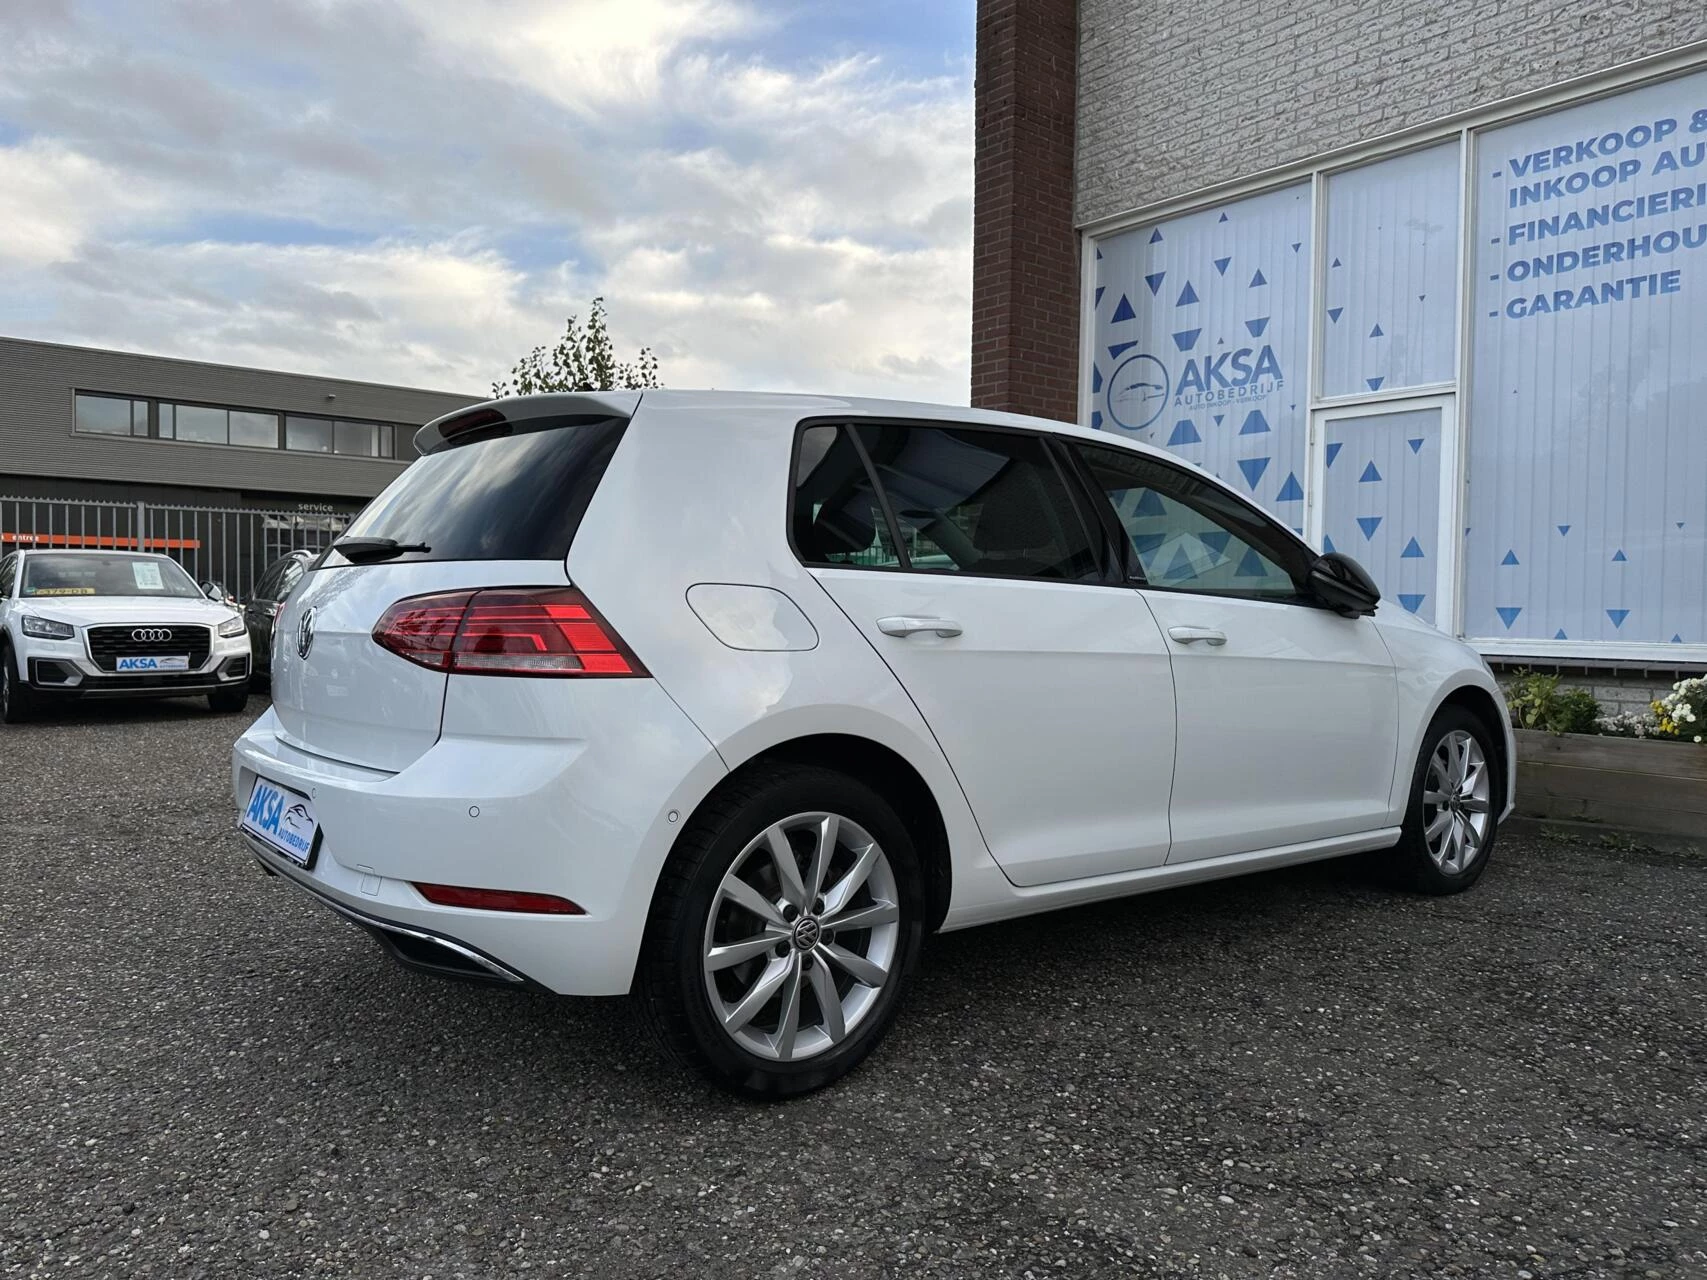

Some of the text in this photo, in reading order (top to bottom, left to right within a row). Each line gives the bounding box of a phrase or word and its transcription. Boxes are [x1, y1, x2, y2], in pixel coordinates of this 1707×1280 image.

[1508, 118, 1678, 178] VERKOOP
[1509, 141, 1707, 209] INKOOP AU
[1508, 182, 1707, 246] FINANCIERI
[1507, 223, 1707, 282] ONDERHOU
[1506, 269, 1681, 319] GARANTIE
[1174, 379, 1285, 407] AUTOBEDRIJF
[1175, 344, 1284, 397] AKSA
[298, 502, 334, 512] service
[119, 658, 158, 670] AKSA
[247, 784, 285, 837] AKSA
